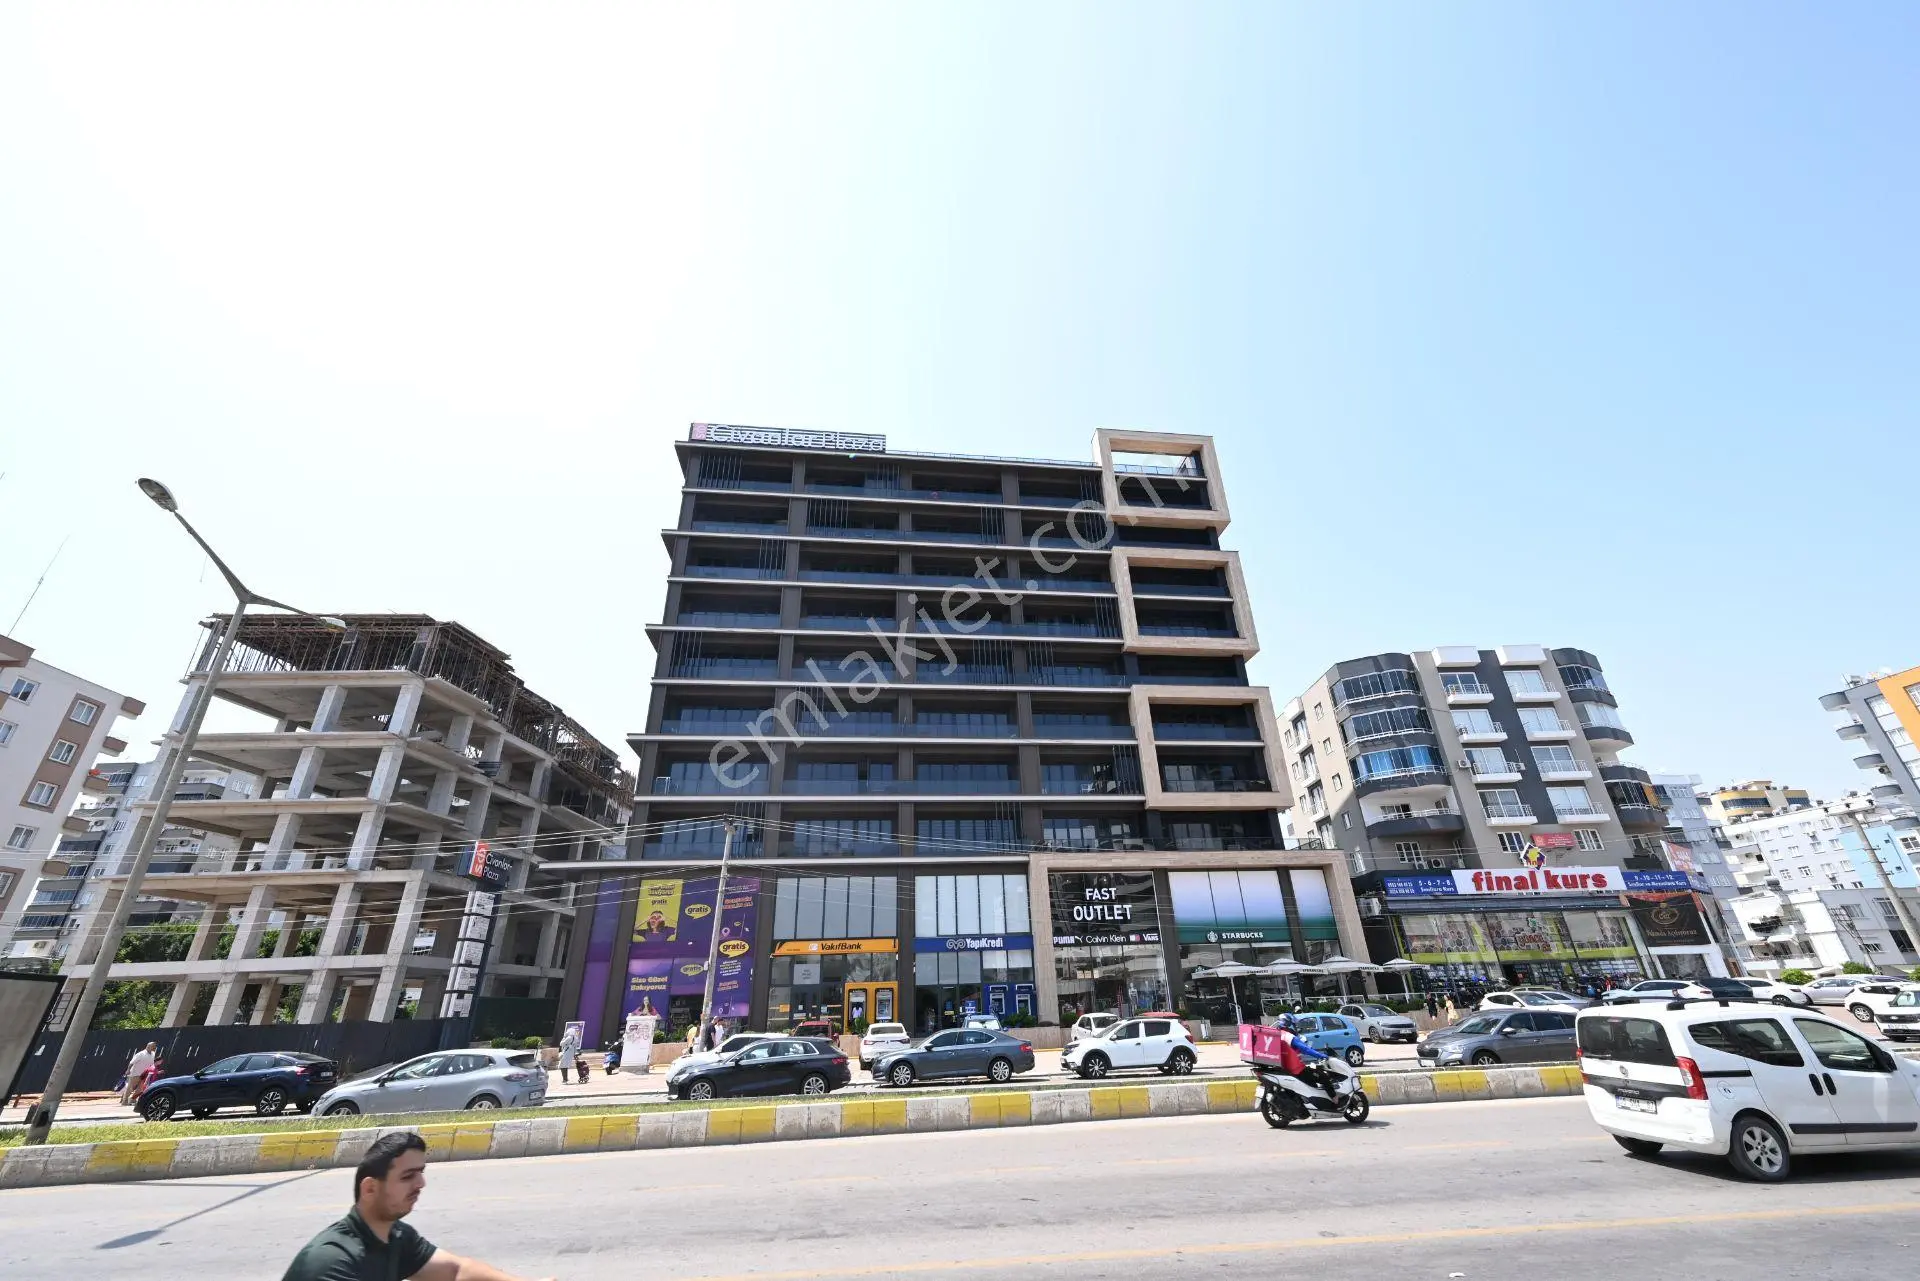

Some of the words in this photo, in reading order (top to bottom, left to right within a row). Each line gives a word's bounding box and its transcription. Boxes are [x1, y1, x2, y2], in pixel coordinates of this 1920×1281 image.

[711, 424, 821, 448] Civanlar
[822, 430, 884, 451] Plaza
[483, 866, 499, 880] Plaza
[1472, 871, 1539, 891] final
[1543, 870, 1608, 889] kurs
[1085, 888, 1117, 900] FAST
[688, 905, 709, 915] gratis
[1073, 904, 1133, 921] OUTLET
[1053, 935, 1075, 944] PUMA
[1086, 935, 1109, 943] Calvin
[1110, 934, 1127, 943] Klein
[722, 942, 746, 952] gratis
[1263, 1035, 1273, 1052] Y
